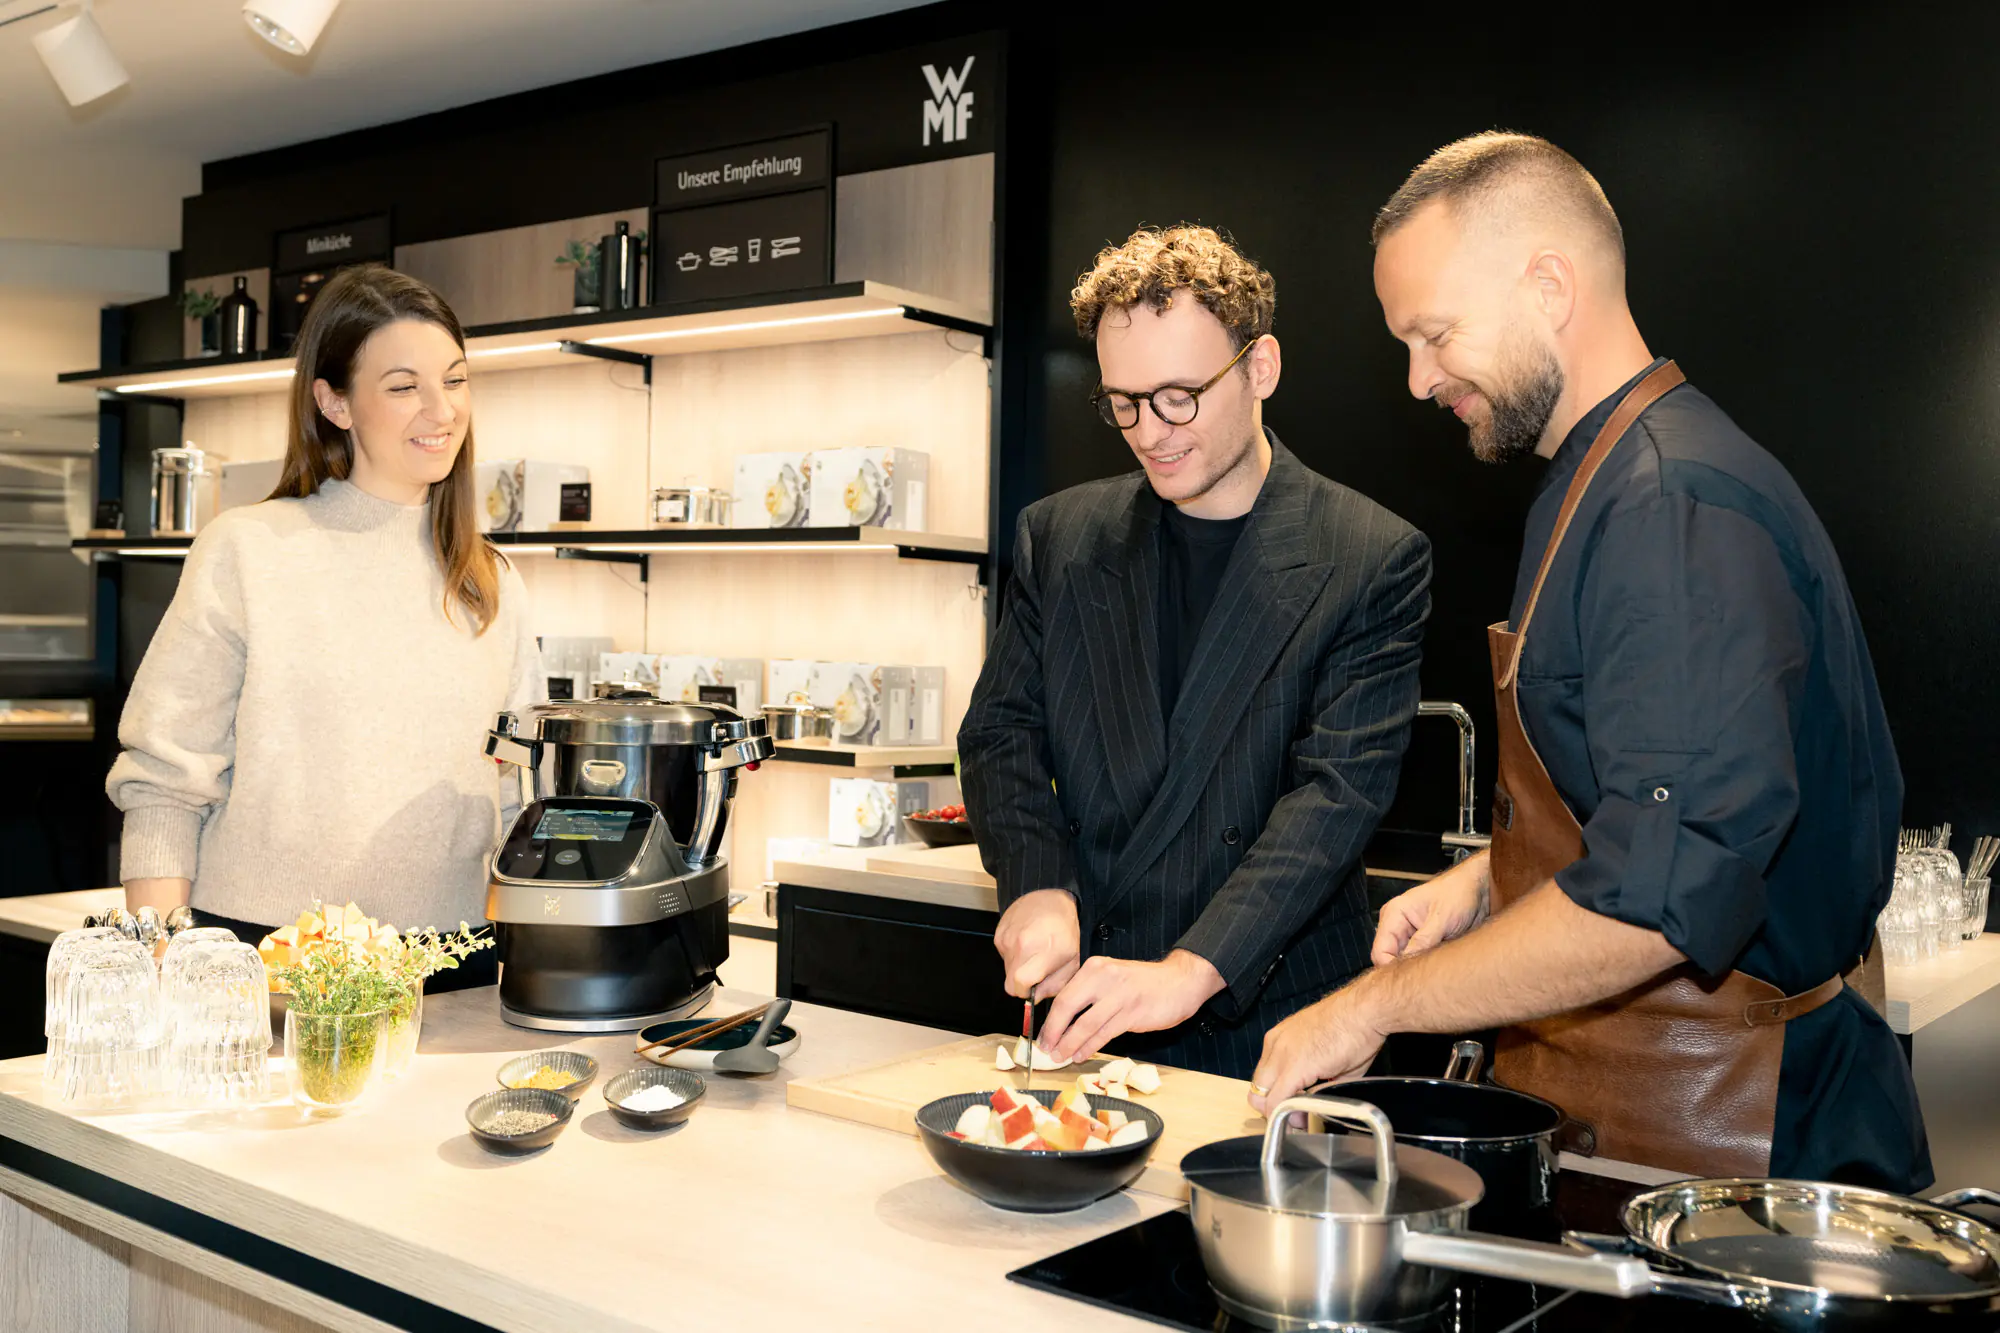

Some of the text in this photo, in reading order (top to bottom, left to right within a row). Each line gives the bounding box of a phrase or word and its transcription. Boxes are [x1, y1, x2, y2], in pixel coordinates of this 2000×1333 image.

[921, 55, 976, 147] WMF
[677, 156, 802, 190] Unsere Empfehlung
